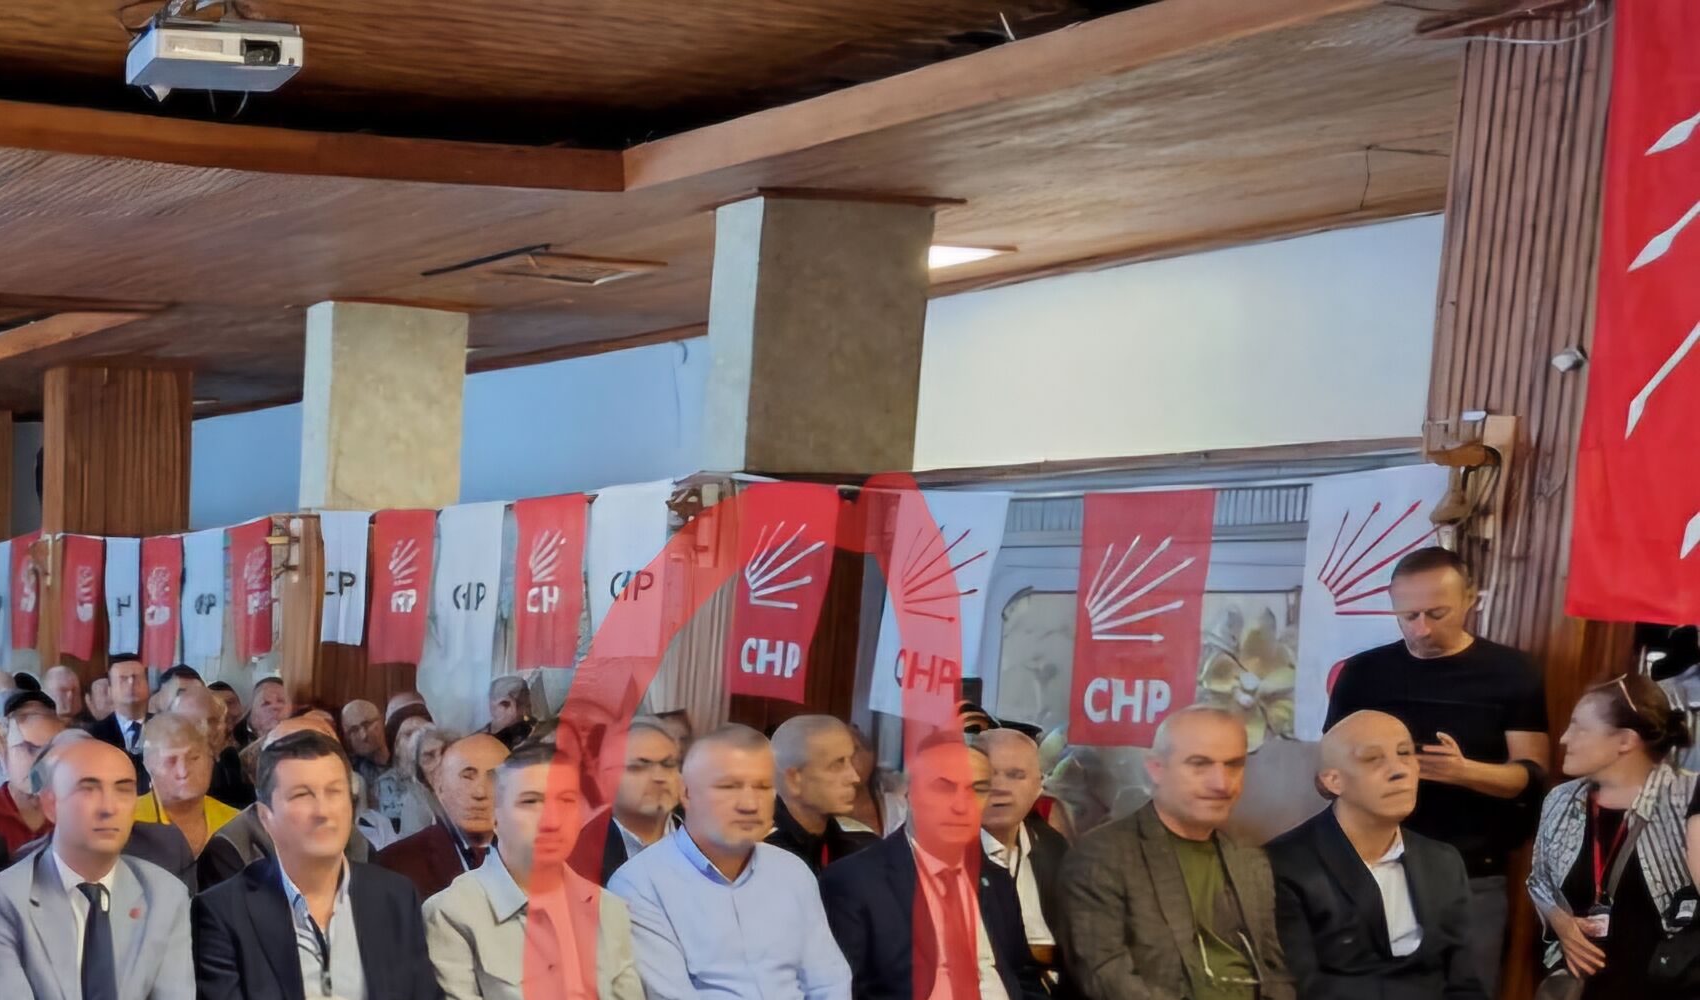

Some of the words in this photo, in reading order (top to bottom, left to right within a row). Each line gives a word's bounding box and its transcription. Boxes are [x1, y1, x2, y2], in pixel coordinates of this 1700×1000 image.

[740, 637, 800, 678] CHP
[895, 648, 960, 695] CHP
[1083, 677, 1171, 723] CHP
